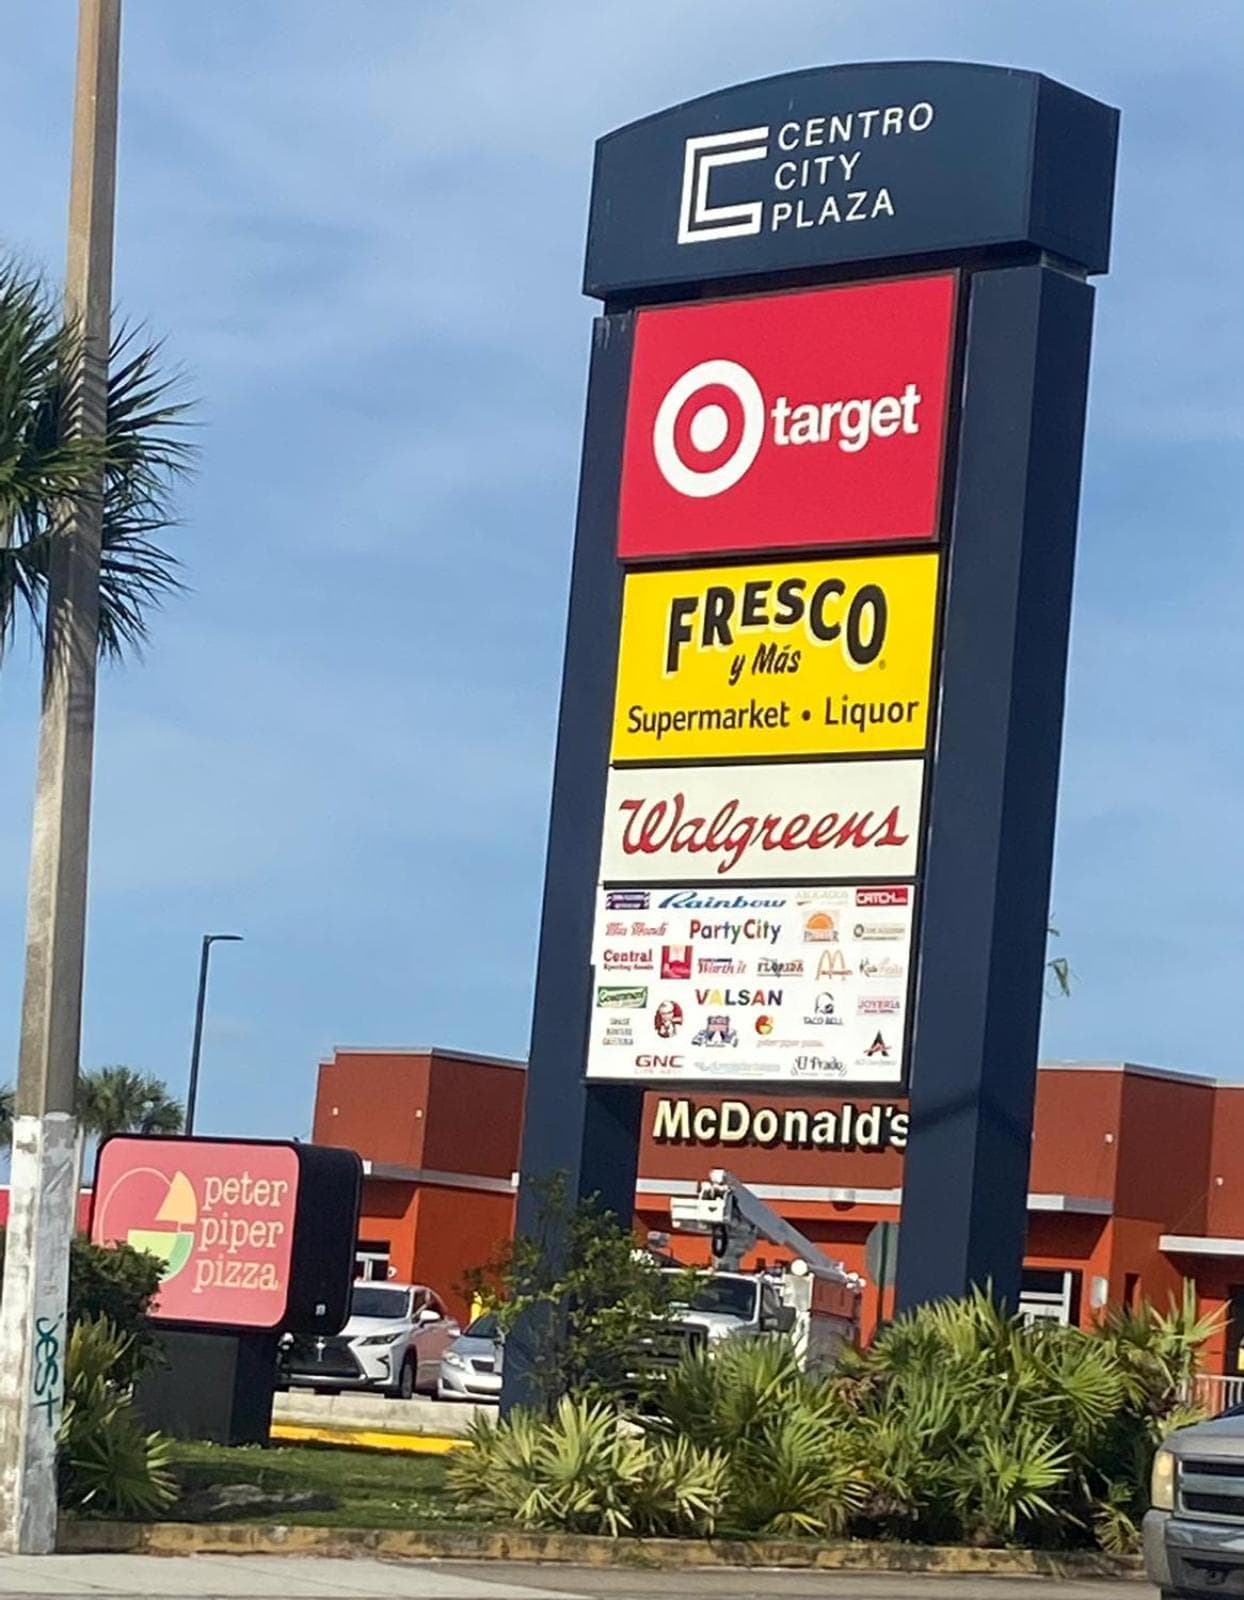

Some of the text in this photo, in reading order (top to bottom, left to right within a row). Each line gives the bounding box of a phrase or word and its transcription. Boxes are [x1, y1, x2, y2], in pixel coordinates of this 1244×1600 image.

[778, 102, 933, 150] CENTRO
[774, 152, 861, 190] CITY
[771, 188, 895, 232] PLAZA
[771, 384, 921, 453] target
[666, 578, 888, 674] FRESCO
[728, 642, 801, 686] y Más
[627, 694, 919, 740] Supermarket Liquor
[618, 792, 909, 874] Walgreens
[658, 891, 787, 909] Rainbow
[603, 948, 653, 963] Central
[695, 989, 783, 1007] VALSAN
[635, 1055, 684, 1068] GNC
[652, 1100, 909, 1147] McDonald's
[202, 1171, 289, 1211] peter
[198, 1212, 284, 1253] piper
[192, 1254, 280, 1293] pizza
